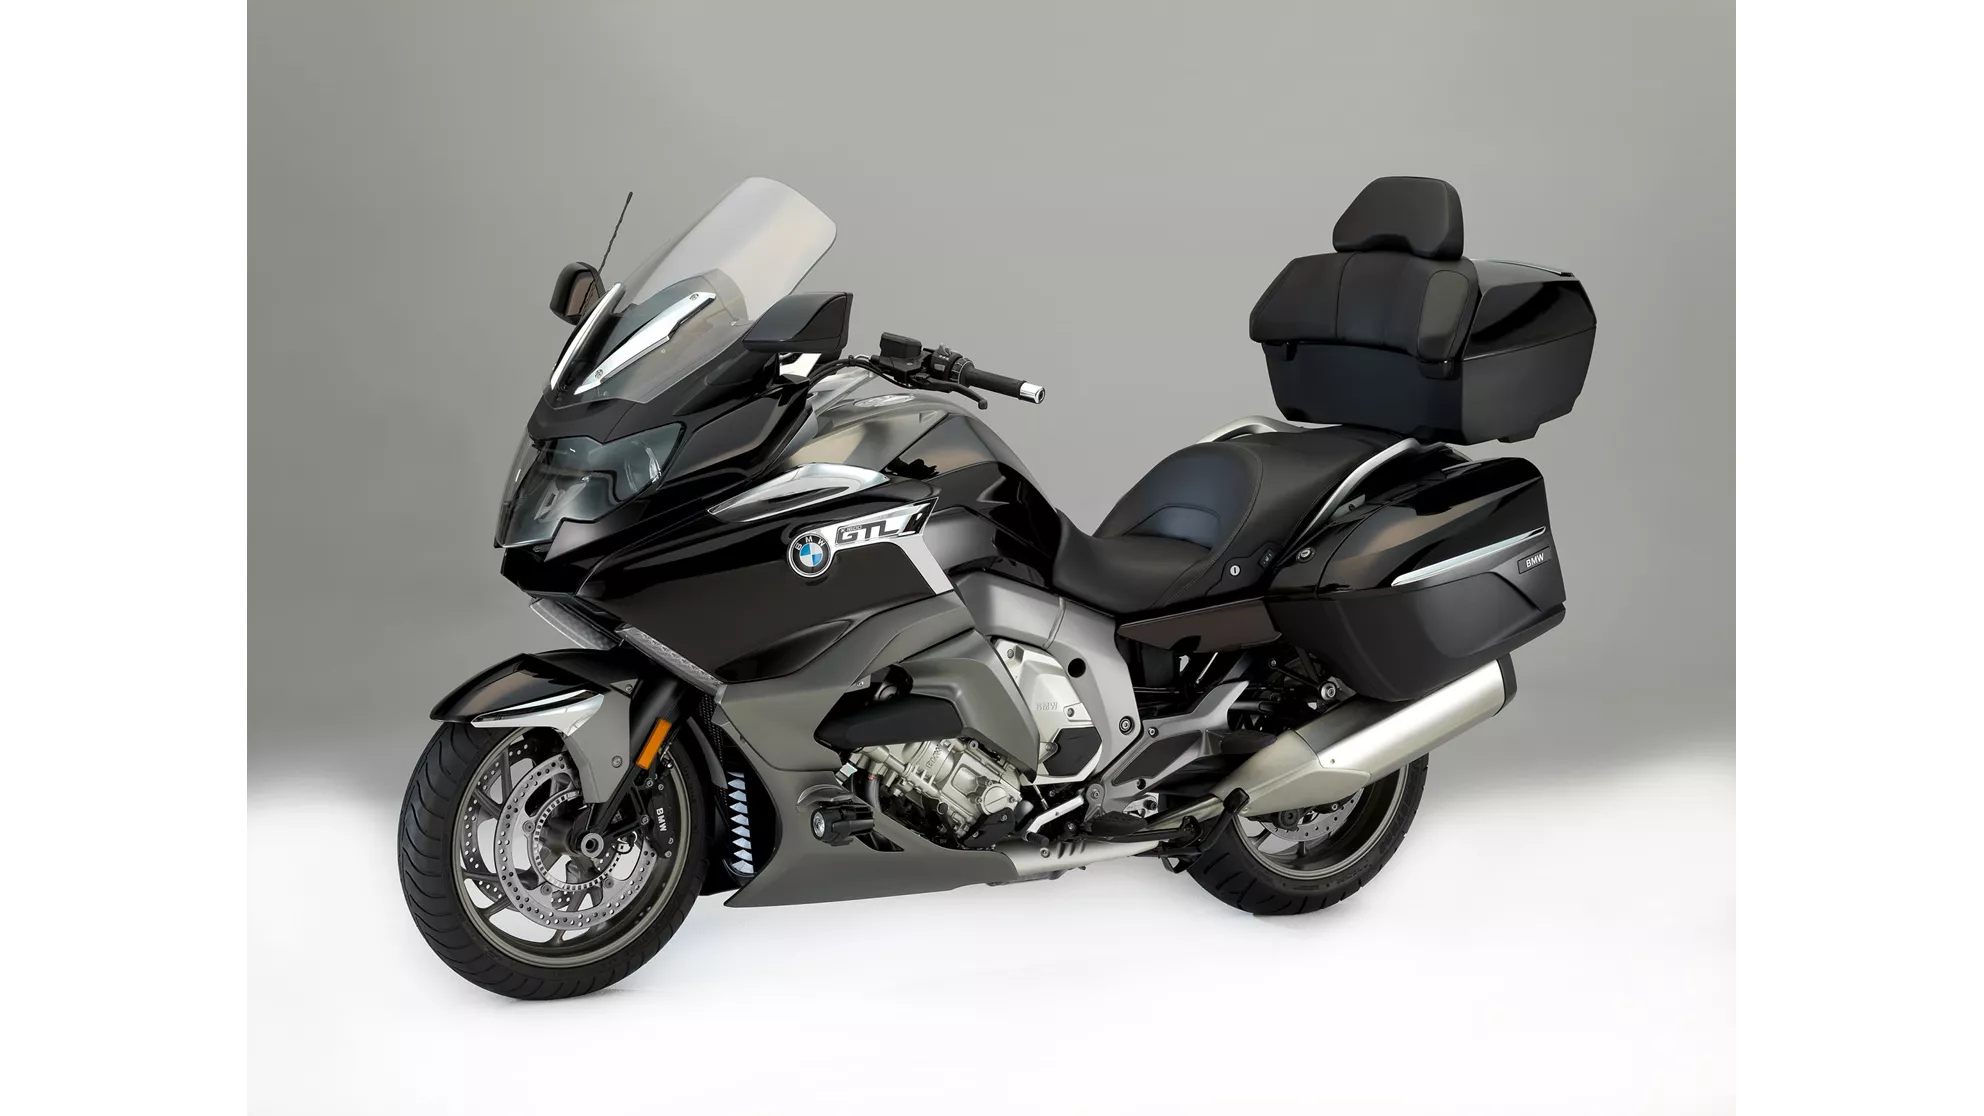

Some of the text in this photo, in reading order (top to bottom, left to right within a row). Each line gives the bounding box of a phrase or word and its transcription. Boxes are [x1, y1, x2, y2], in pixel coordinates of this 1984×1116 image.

[835, 520, 900, 544] GTL
[795, 536, 826, 551] BMW
[1525, 552, 1544, 568] BMW
[656, 807, 668, 832] BMW
